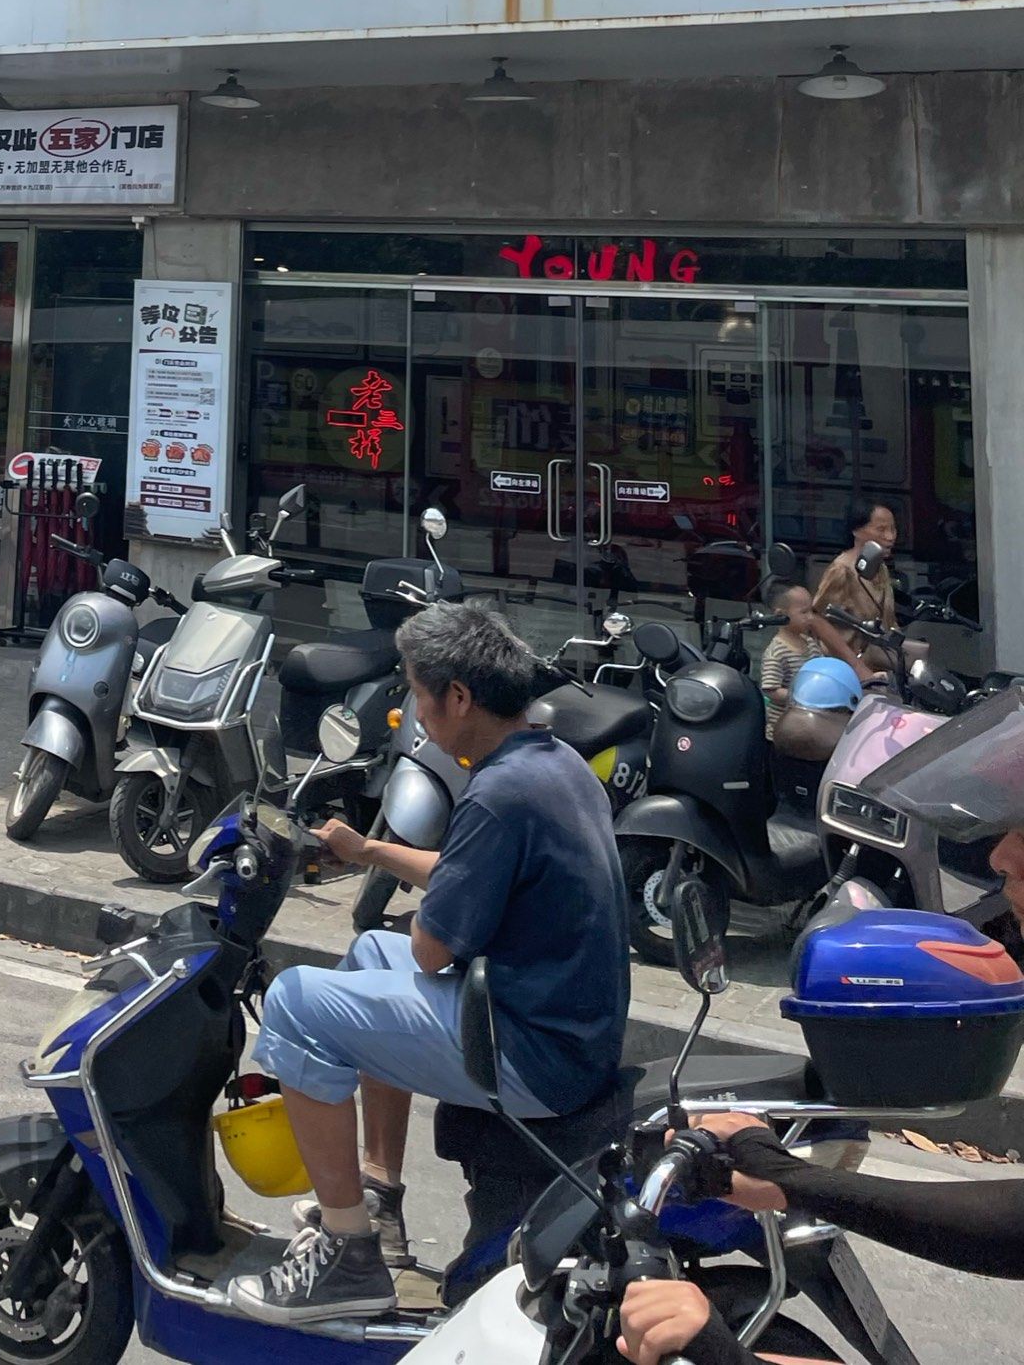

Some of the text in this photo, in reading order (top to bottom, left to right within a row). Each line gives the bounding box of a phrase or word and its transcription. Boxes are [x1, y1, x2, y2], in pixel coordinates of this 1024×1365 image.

[499, 234, 701, 283] YOUNG
[140, 303, 180, 325] 等位
[179, 326, 218, 344] 公告
[348, 370, 404, 469] 老三样
